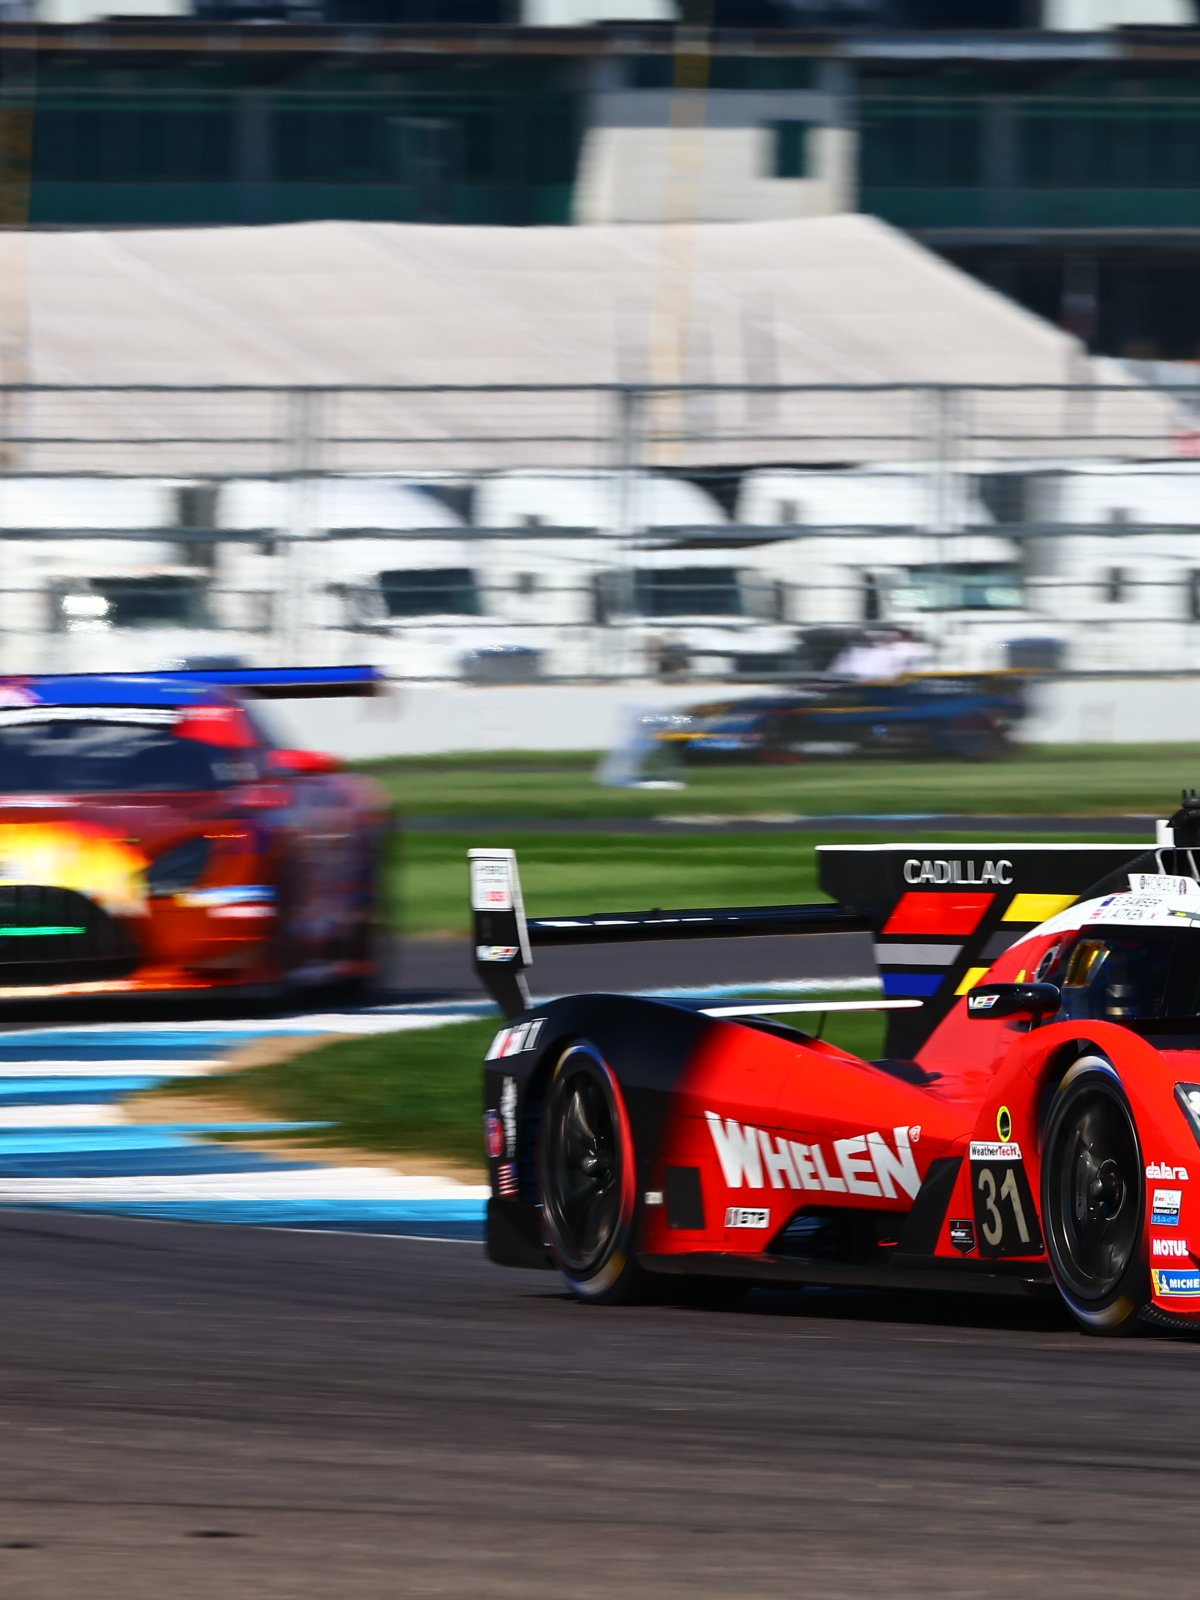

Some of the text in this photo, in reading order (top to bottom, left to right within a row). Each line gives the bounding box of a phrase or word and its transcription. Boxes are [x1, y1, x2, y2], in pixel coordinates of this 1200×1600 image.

[903, 859, 1014, 885] CADILLAC
[703, 1109, 924, 1201] WHELEN
[971, 1145, 1017, 1157] WeatherTech
[978, 1168, 1031, 1246] 31
[1152, 1239, 1190, 1257] MOTUL
